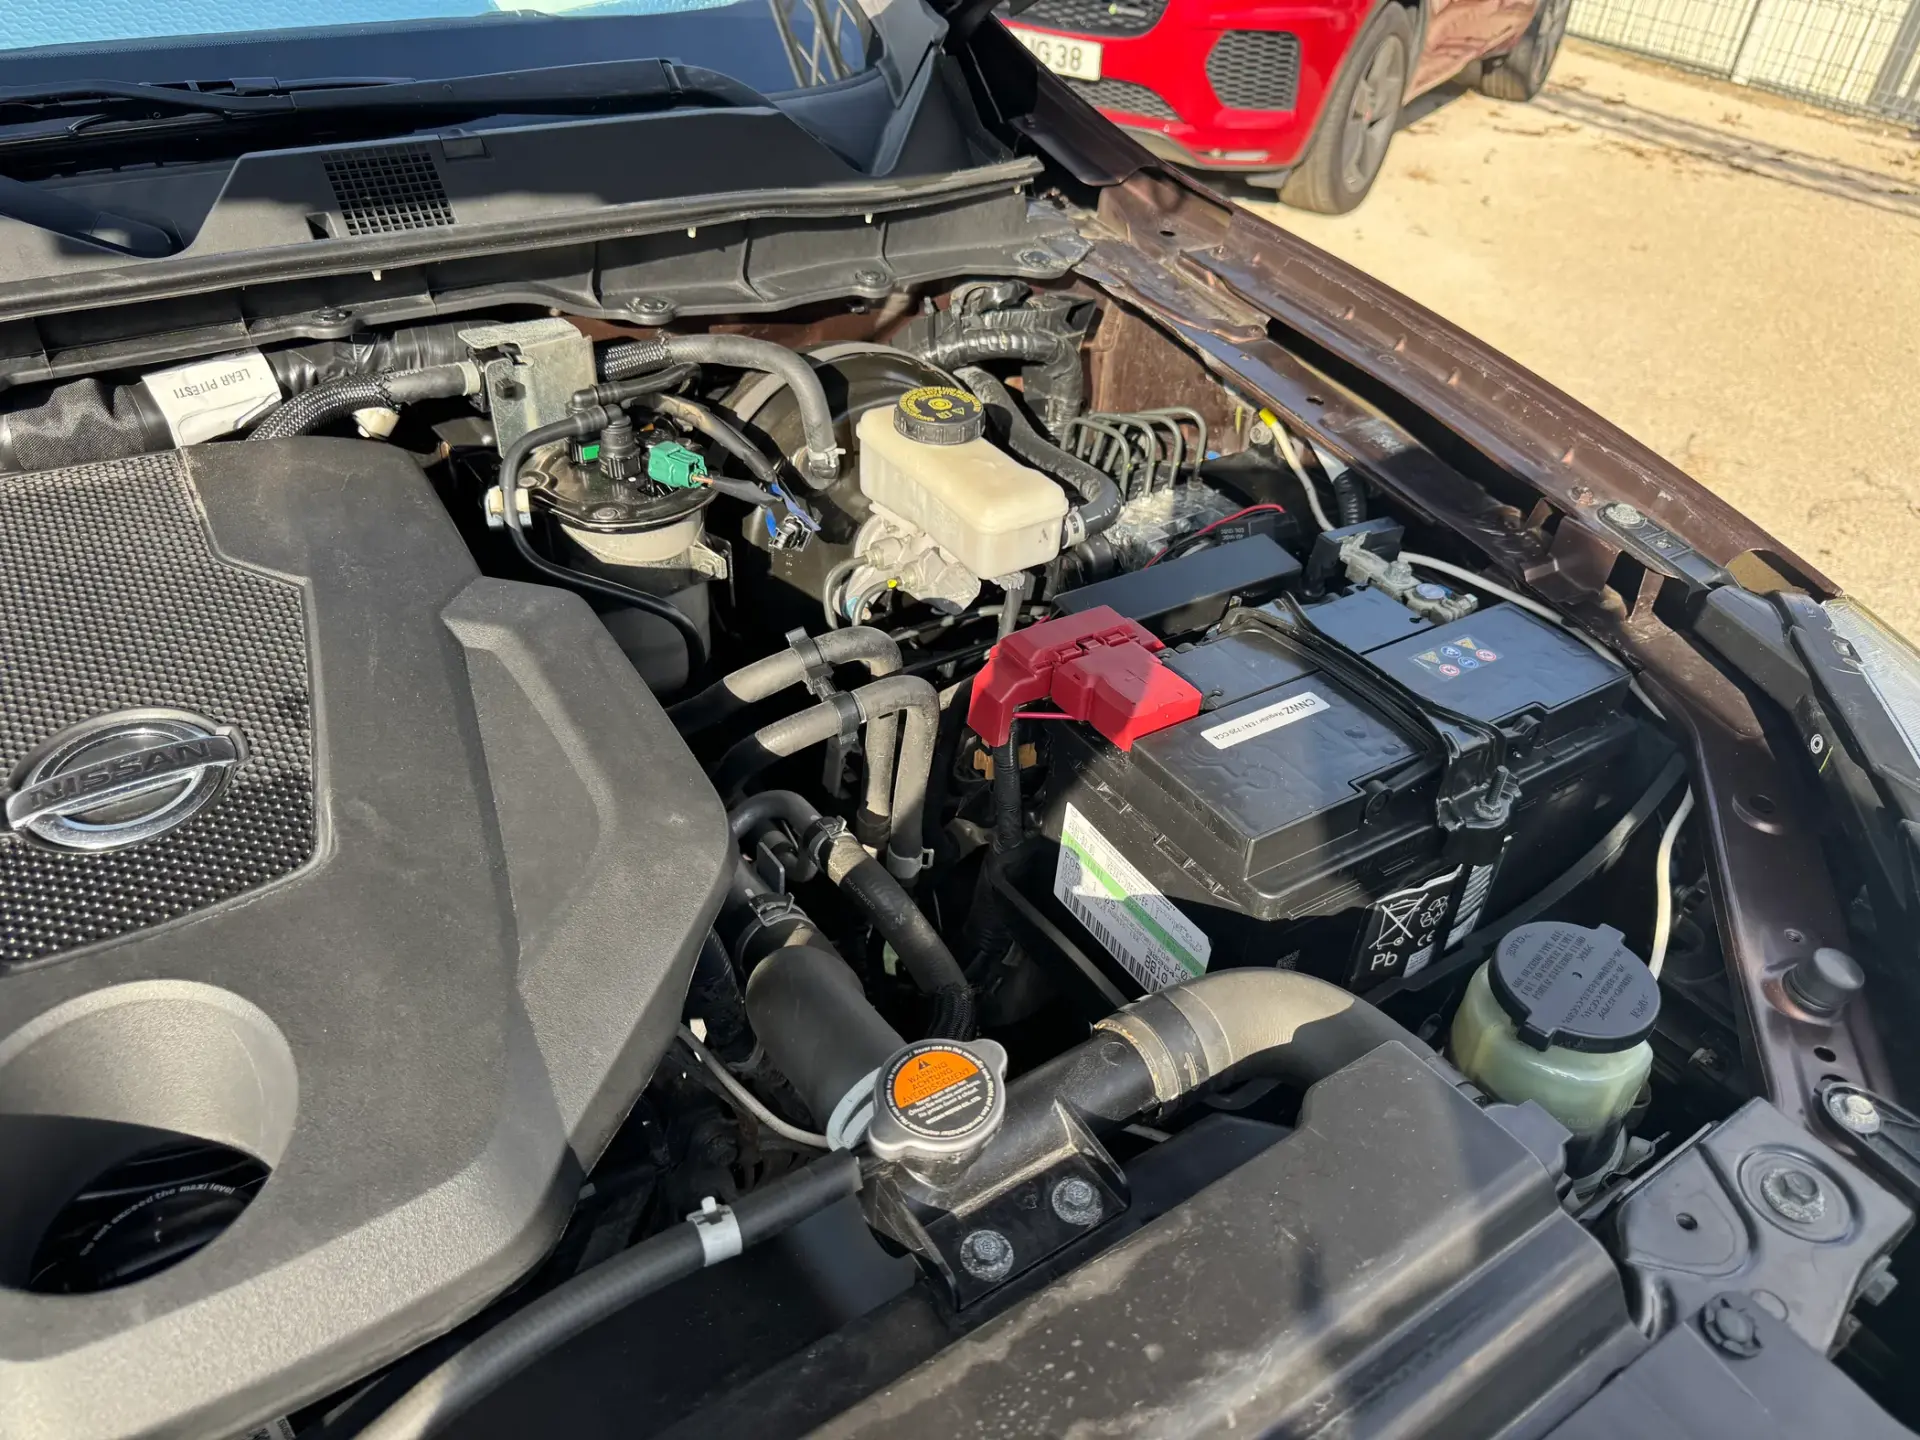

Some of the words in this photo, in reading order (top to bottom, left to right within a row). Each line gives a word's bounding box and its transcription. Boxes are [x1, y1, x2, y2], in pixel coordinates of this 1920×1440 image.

[220, 368, 252, 387] LEAR
[172, 378, 219, 400] PITESTI
[1284, 698, 1316, 715] CNWZ
[30, 741, 213, 810] NISSAN
[1370, 951, 1398, 971] Pb
[907, 1061, 948, 1083] WARNING
[912, 1067, 953, 1090] ACHTUNG
[903, 1068, 970, 1103] AVERTISSEMENT
[155, 1188, 176, 1200] the
[179, 1182, 208, 1193] maxi
[208, 1182, 236, 1195] level
